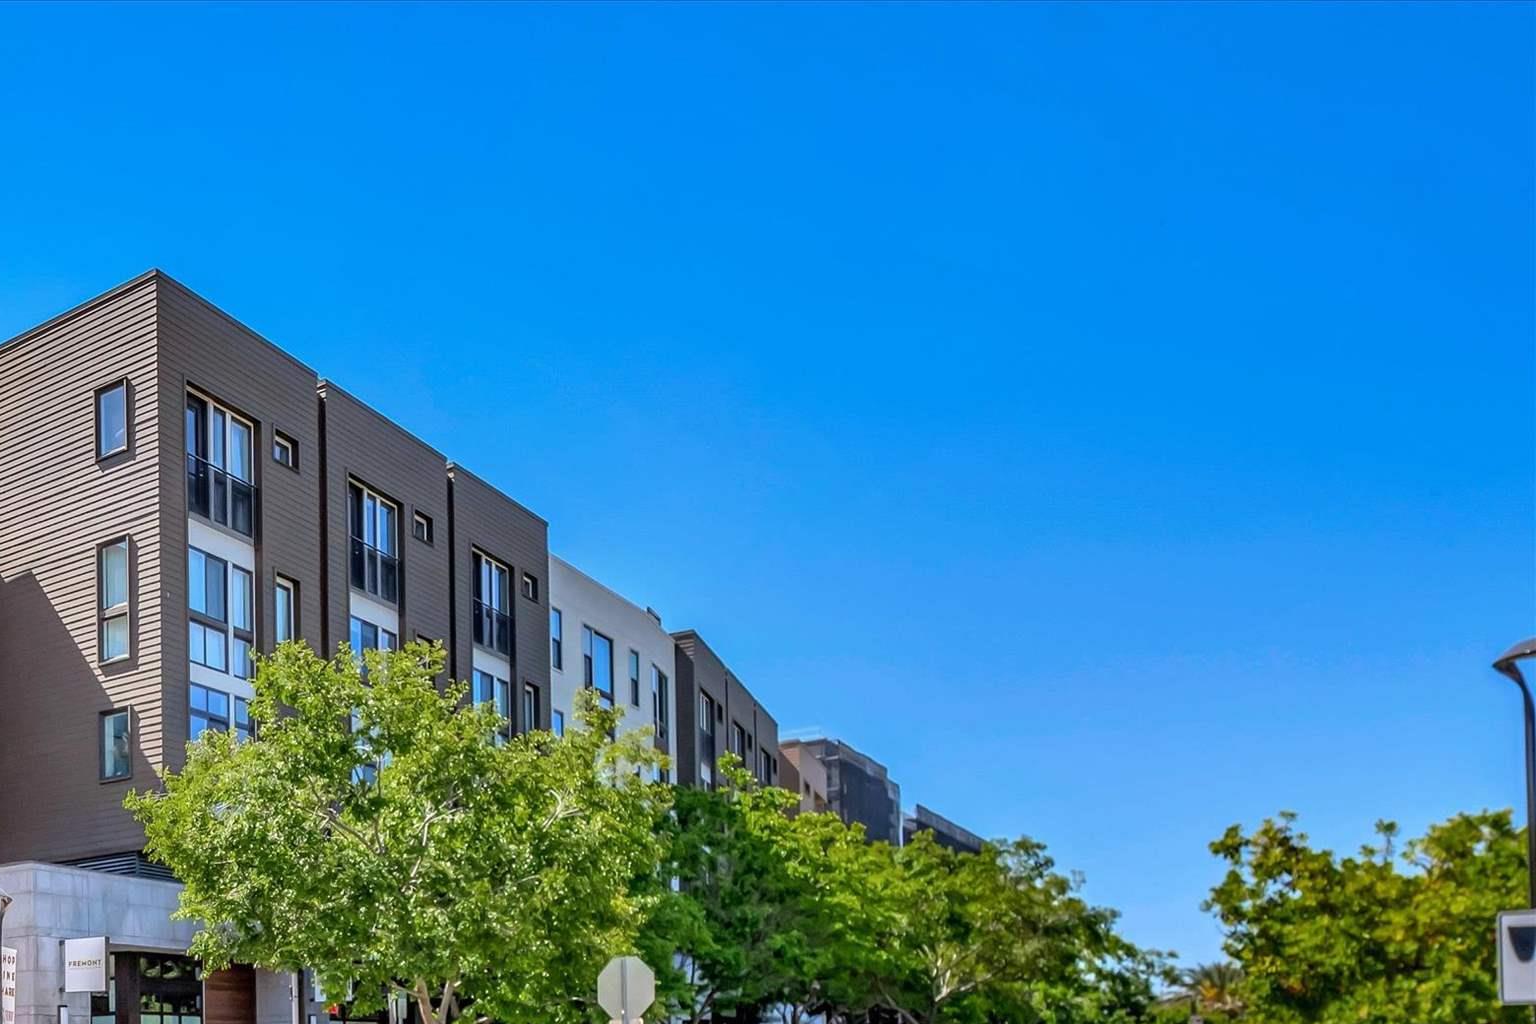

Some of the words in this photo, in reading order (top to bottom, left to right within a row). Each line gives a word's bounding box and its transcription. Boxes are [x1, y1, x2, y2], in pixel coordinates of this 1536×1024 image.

[2, 954, 15, 965] HOP
[68, 959, 101, 967] FREMONT
[2, 970, 15, 981] INE
